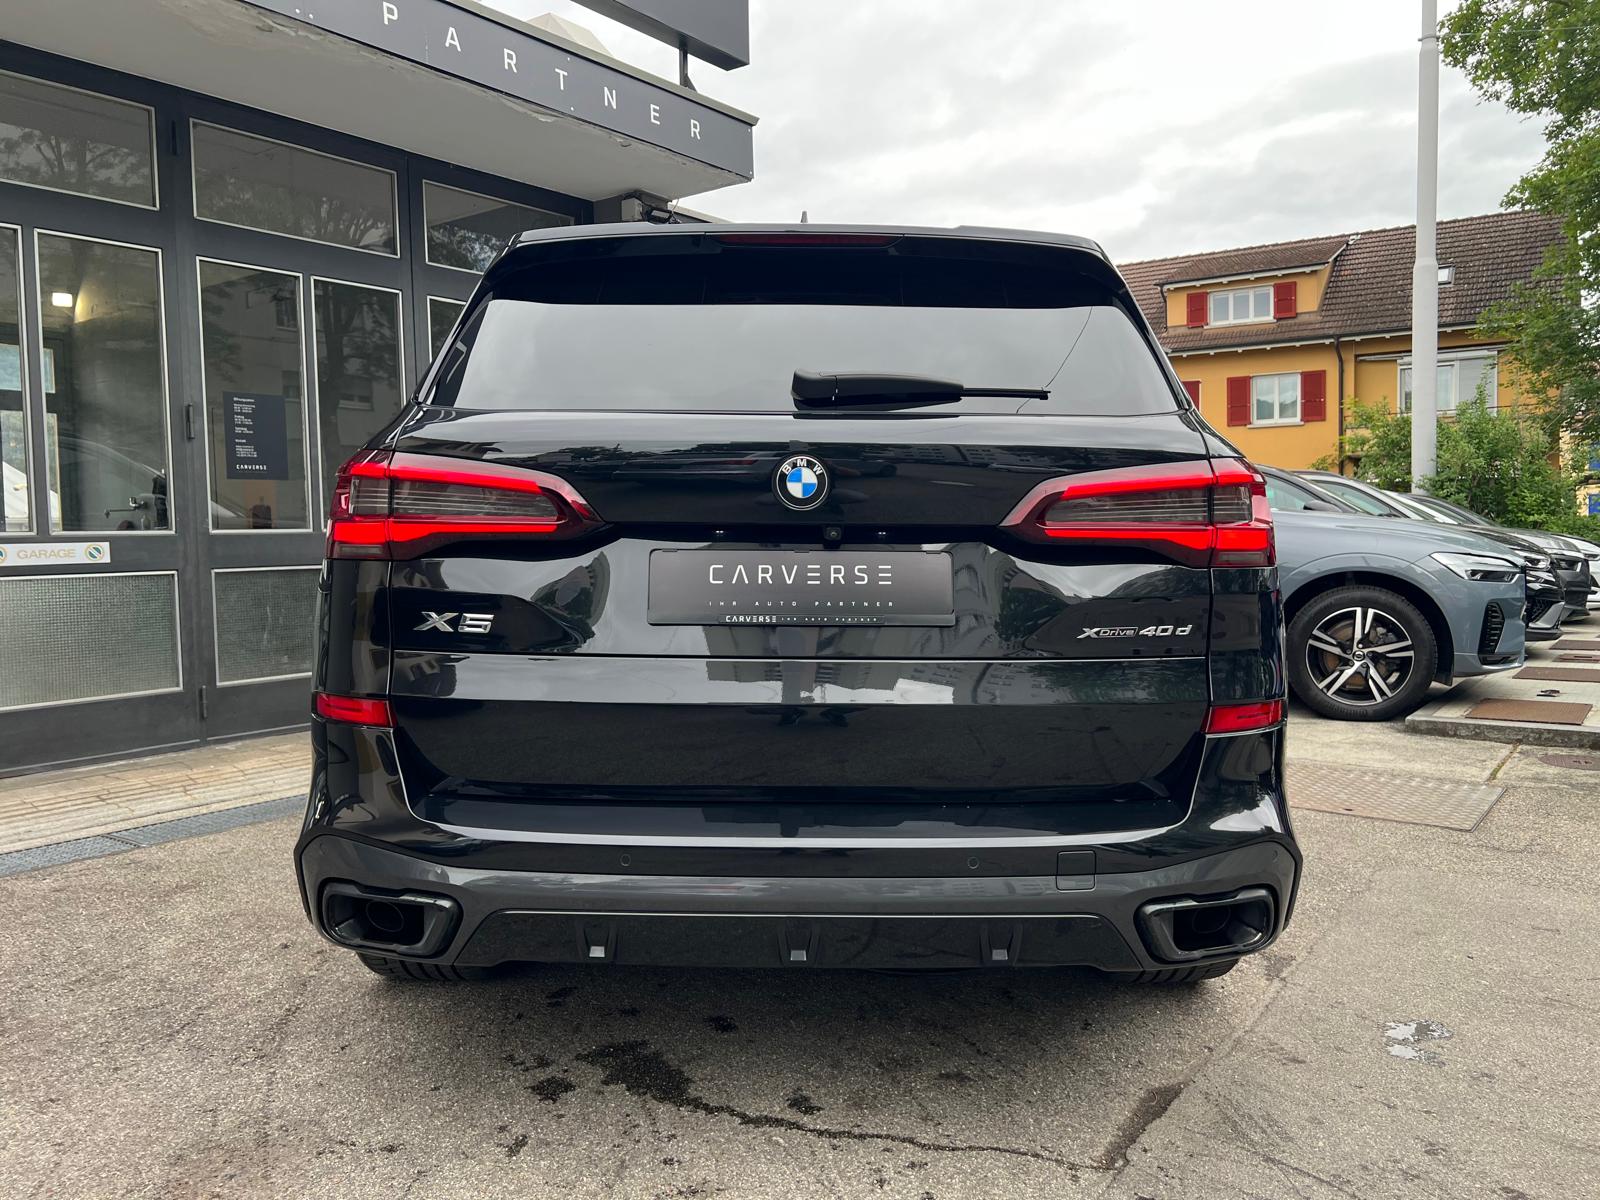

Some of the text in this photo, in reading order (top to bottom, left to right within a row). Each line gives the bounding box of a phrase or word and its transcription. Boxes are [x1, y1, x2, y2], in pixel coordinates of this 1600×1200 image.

[382, 1, 702, 140] PARTNER
[782, 458, 824, 475] BMW
[16, 548, 77, 560] GARAGE
[709, 564, 892, 585] CARVERSE
[413, 611, 494, 633] X5
[725, 615, 777, 623] CARVERSE
